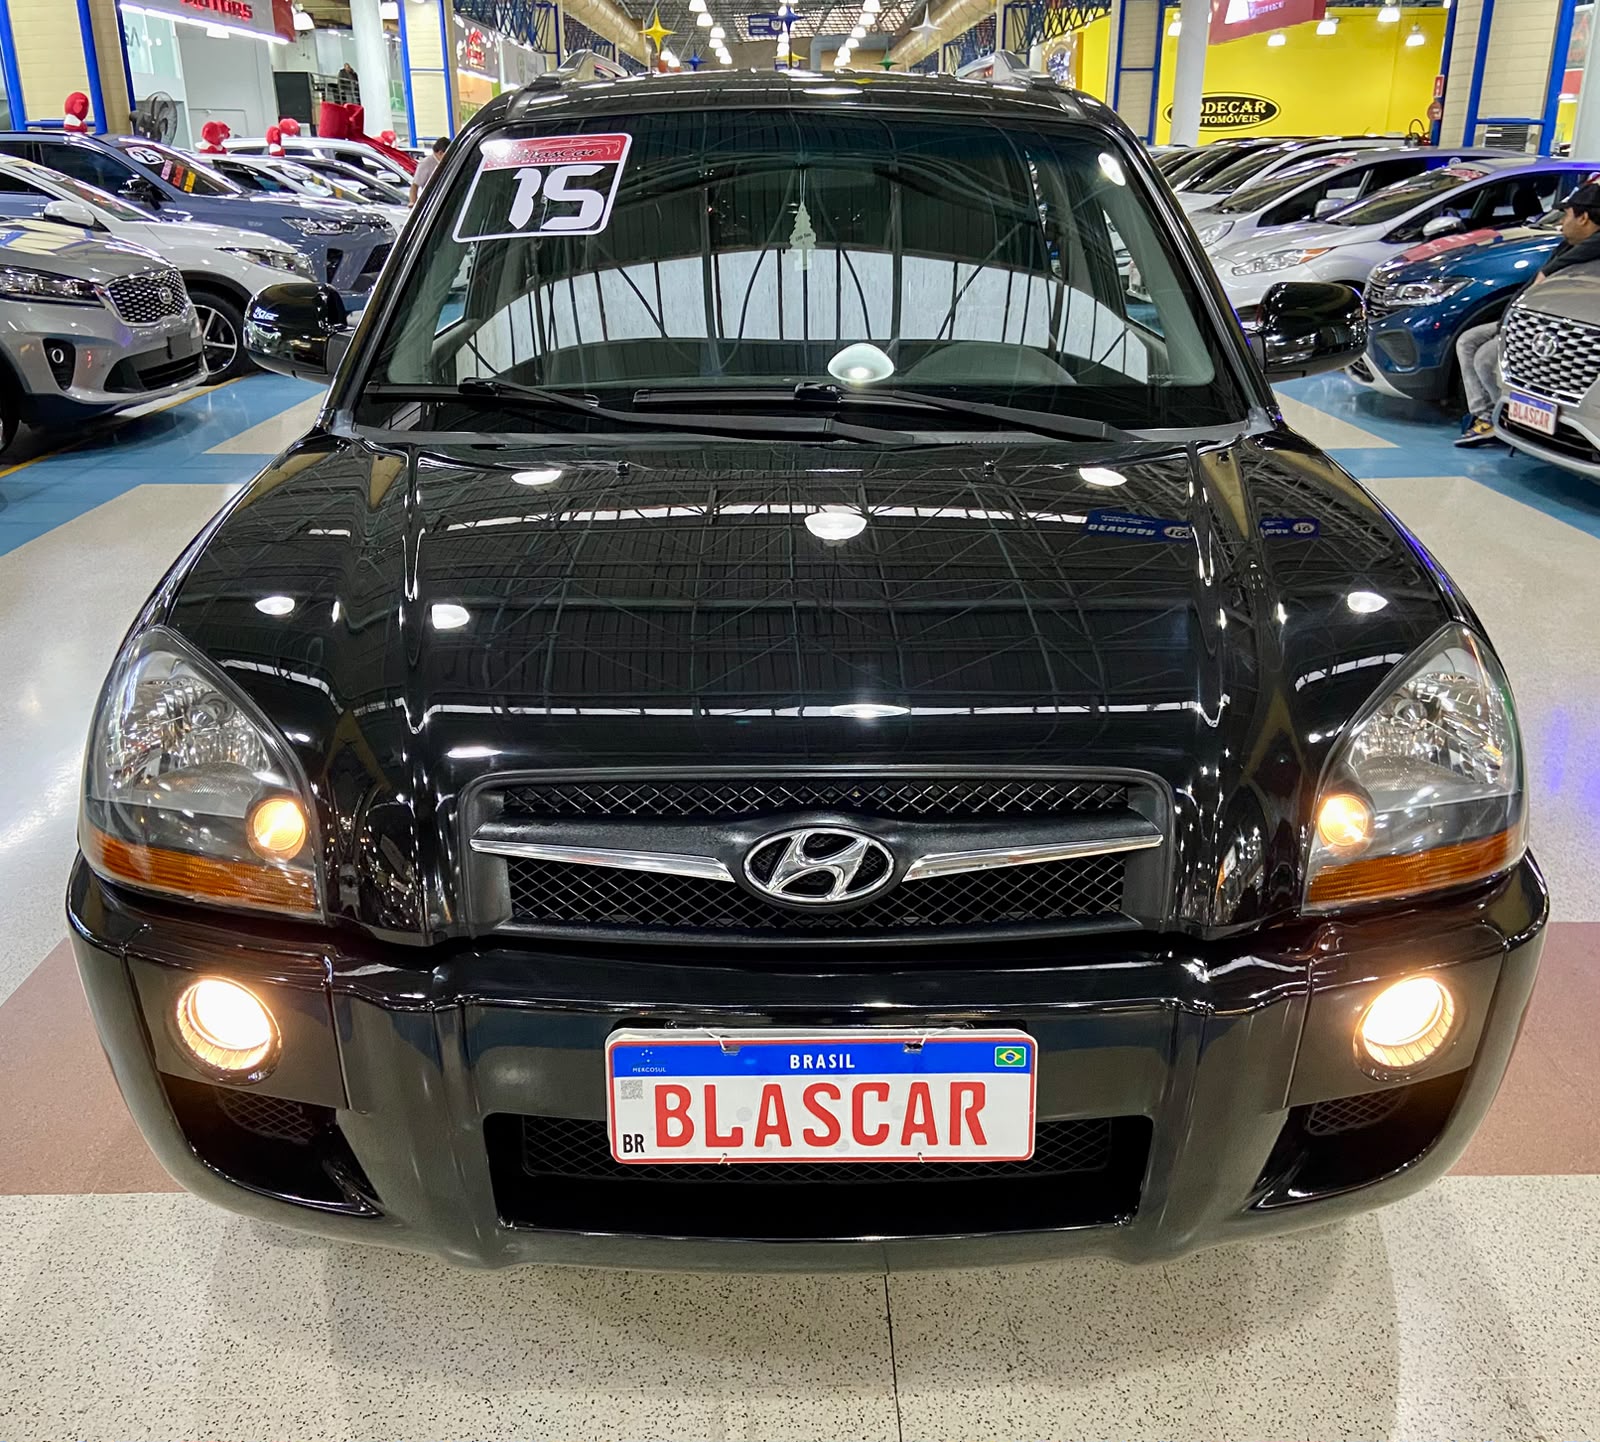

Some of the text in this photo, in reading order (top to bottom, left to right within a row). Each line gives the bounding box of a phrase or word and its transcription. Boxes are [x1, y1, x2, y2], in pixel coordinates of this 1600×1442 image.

[183, 0, 254, 21] TORS
[1199, 112, 1261, 124] TOMÓVEIS
[1200, 100, 1268, 115] DECAR
[508, 165, 605, 231] 15
[1512, 401, 1550, 429] BLASCAR
[790, 1053, 856, 1069] BRASIL
[654, 1081, 988, 1148] BLASCAR
[622, 1133, 646, 1154] BR
